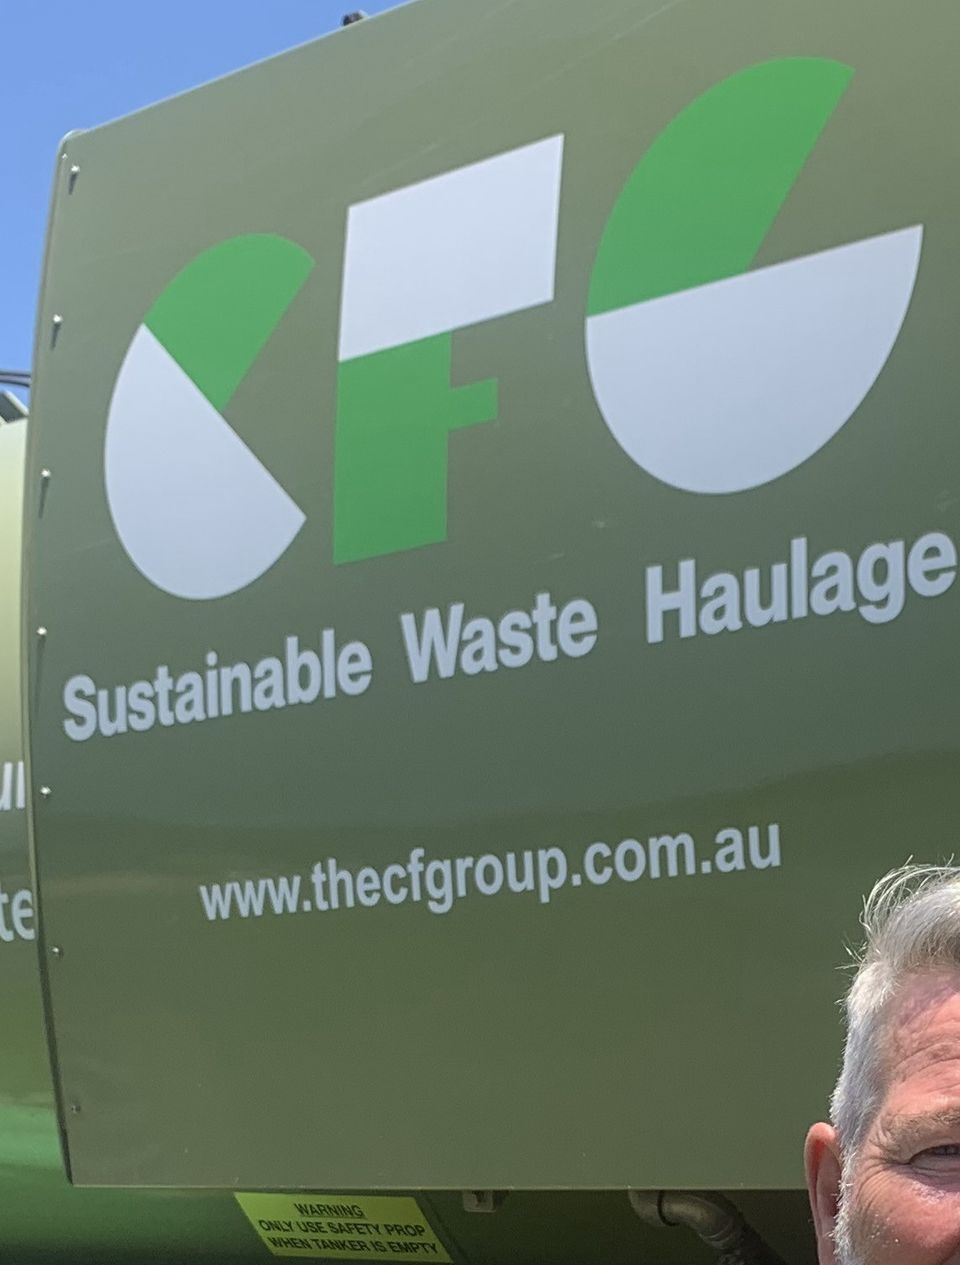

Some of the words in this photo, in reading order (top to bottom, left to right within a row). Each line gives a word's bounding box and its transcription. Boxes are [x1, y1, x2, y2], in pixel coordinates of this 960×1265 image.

[63, 629, 373, 741] Sustainable
[401, 592, 599, 684] Waste
[645, 531, 957, 644] Haulage
[200, 823, 782, 920] www.thecfgroup.com.au
[294, 1202, 364, 1217] WARNING
[258, 1219, 294, 1232] ONLY
[299, 1221, 327, 1233] USE
[330, 1222, 381, 1236] SAFETY
[385, 1224, 426, 1237] PROP
[268, 1236, 313, 1249] WHEN
[315, 1238, 368, 1252] TANKER
[371, 1241, 387, 1253] IS
[389, 1242, 438, 1255] EMPTY
